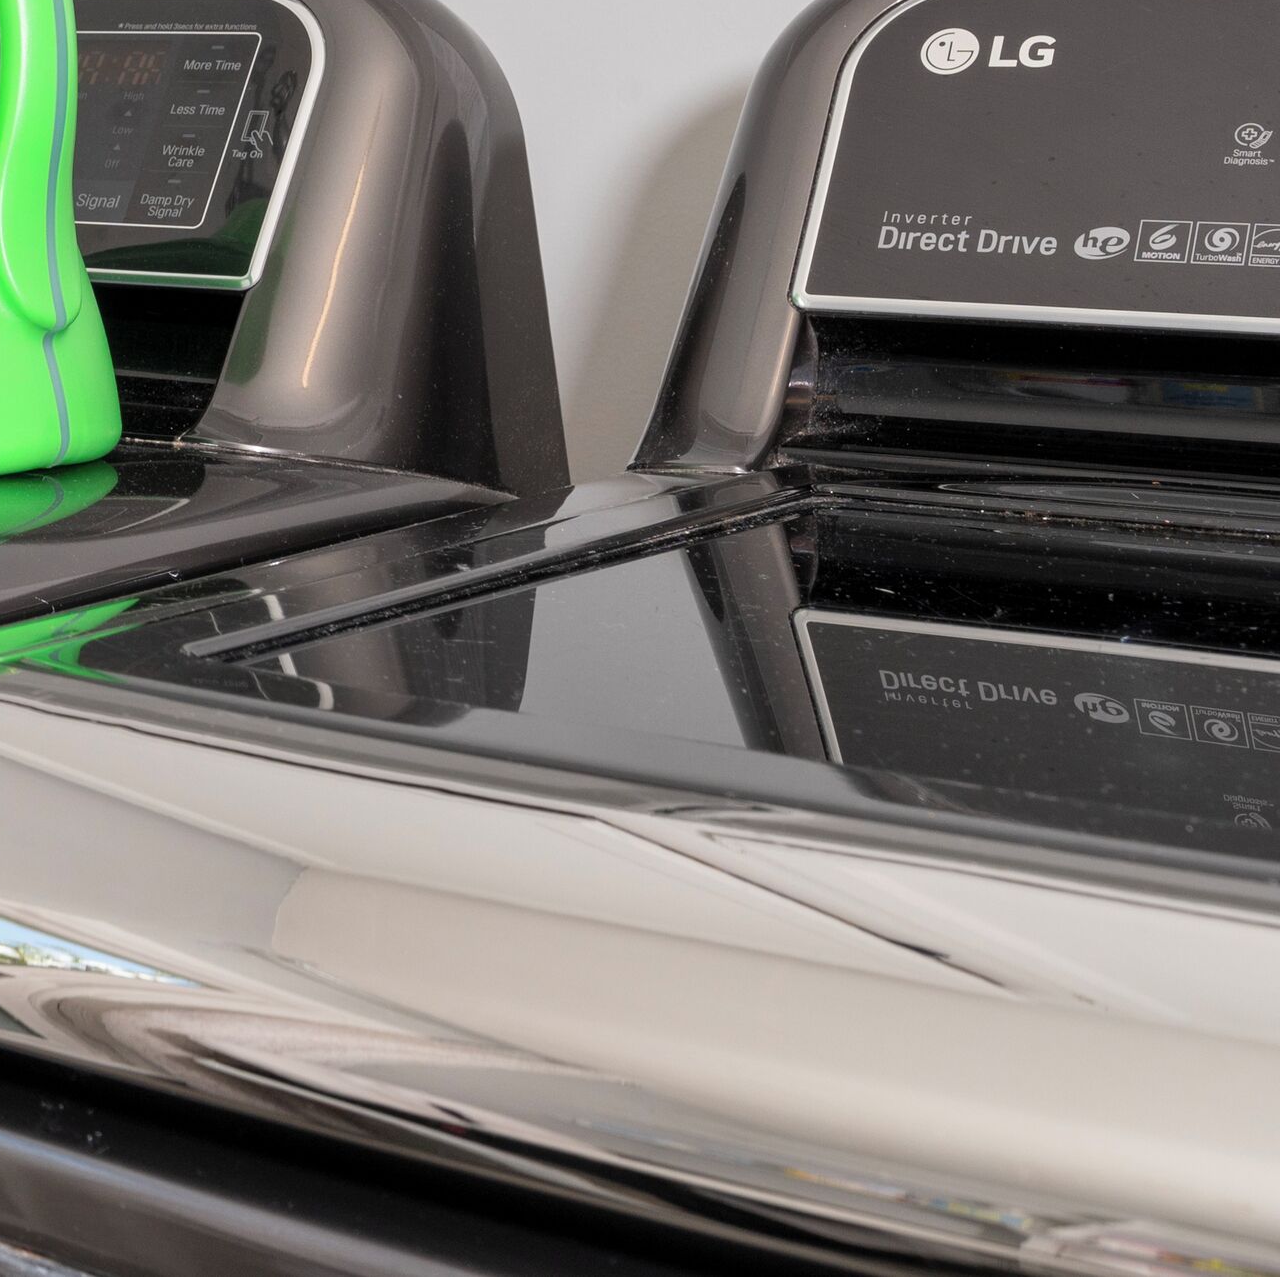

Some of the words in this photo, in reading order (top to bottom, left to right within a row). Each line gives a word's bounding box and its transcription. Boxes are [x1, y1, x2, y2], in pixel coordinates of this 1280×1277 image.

[988, 35, 1056, 68] LG
[184, 60, 212, 71] More
[216, 60, 242, 71] Time
[123, 91, 144, 101] High
[170, 104, 195, 115] Less
[199, 105, 226, 116] Time
[112, 126, 133, 135] Low
[162, 145, 205, 157] Wrinkle
[232, 149, 247, 160] Tag
[250, 150, 263, 159] On
[1233, 149, 1261, 158] Smart
[168, 157, 194, 168] Care
[76, 194, 120, 209] Signal
[140, 194, 172, 206] Damp
[175, 195, 195, 209] Dry
[147, 205, 183, 218] Signal
[883, 211, 973, 225] Inverter
[877, 225, 969, 253] Direct
[977, 229, 1057, 255] Drive
[1142, 252, 1180, 260] MOTION
